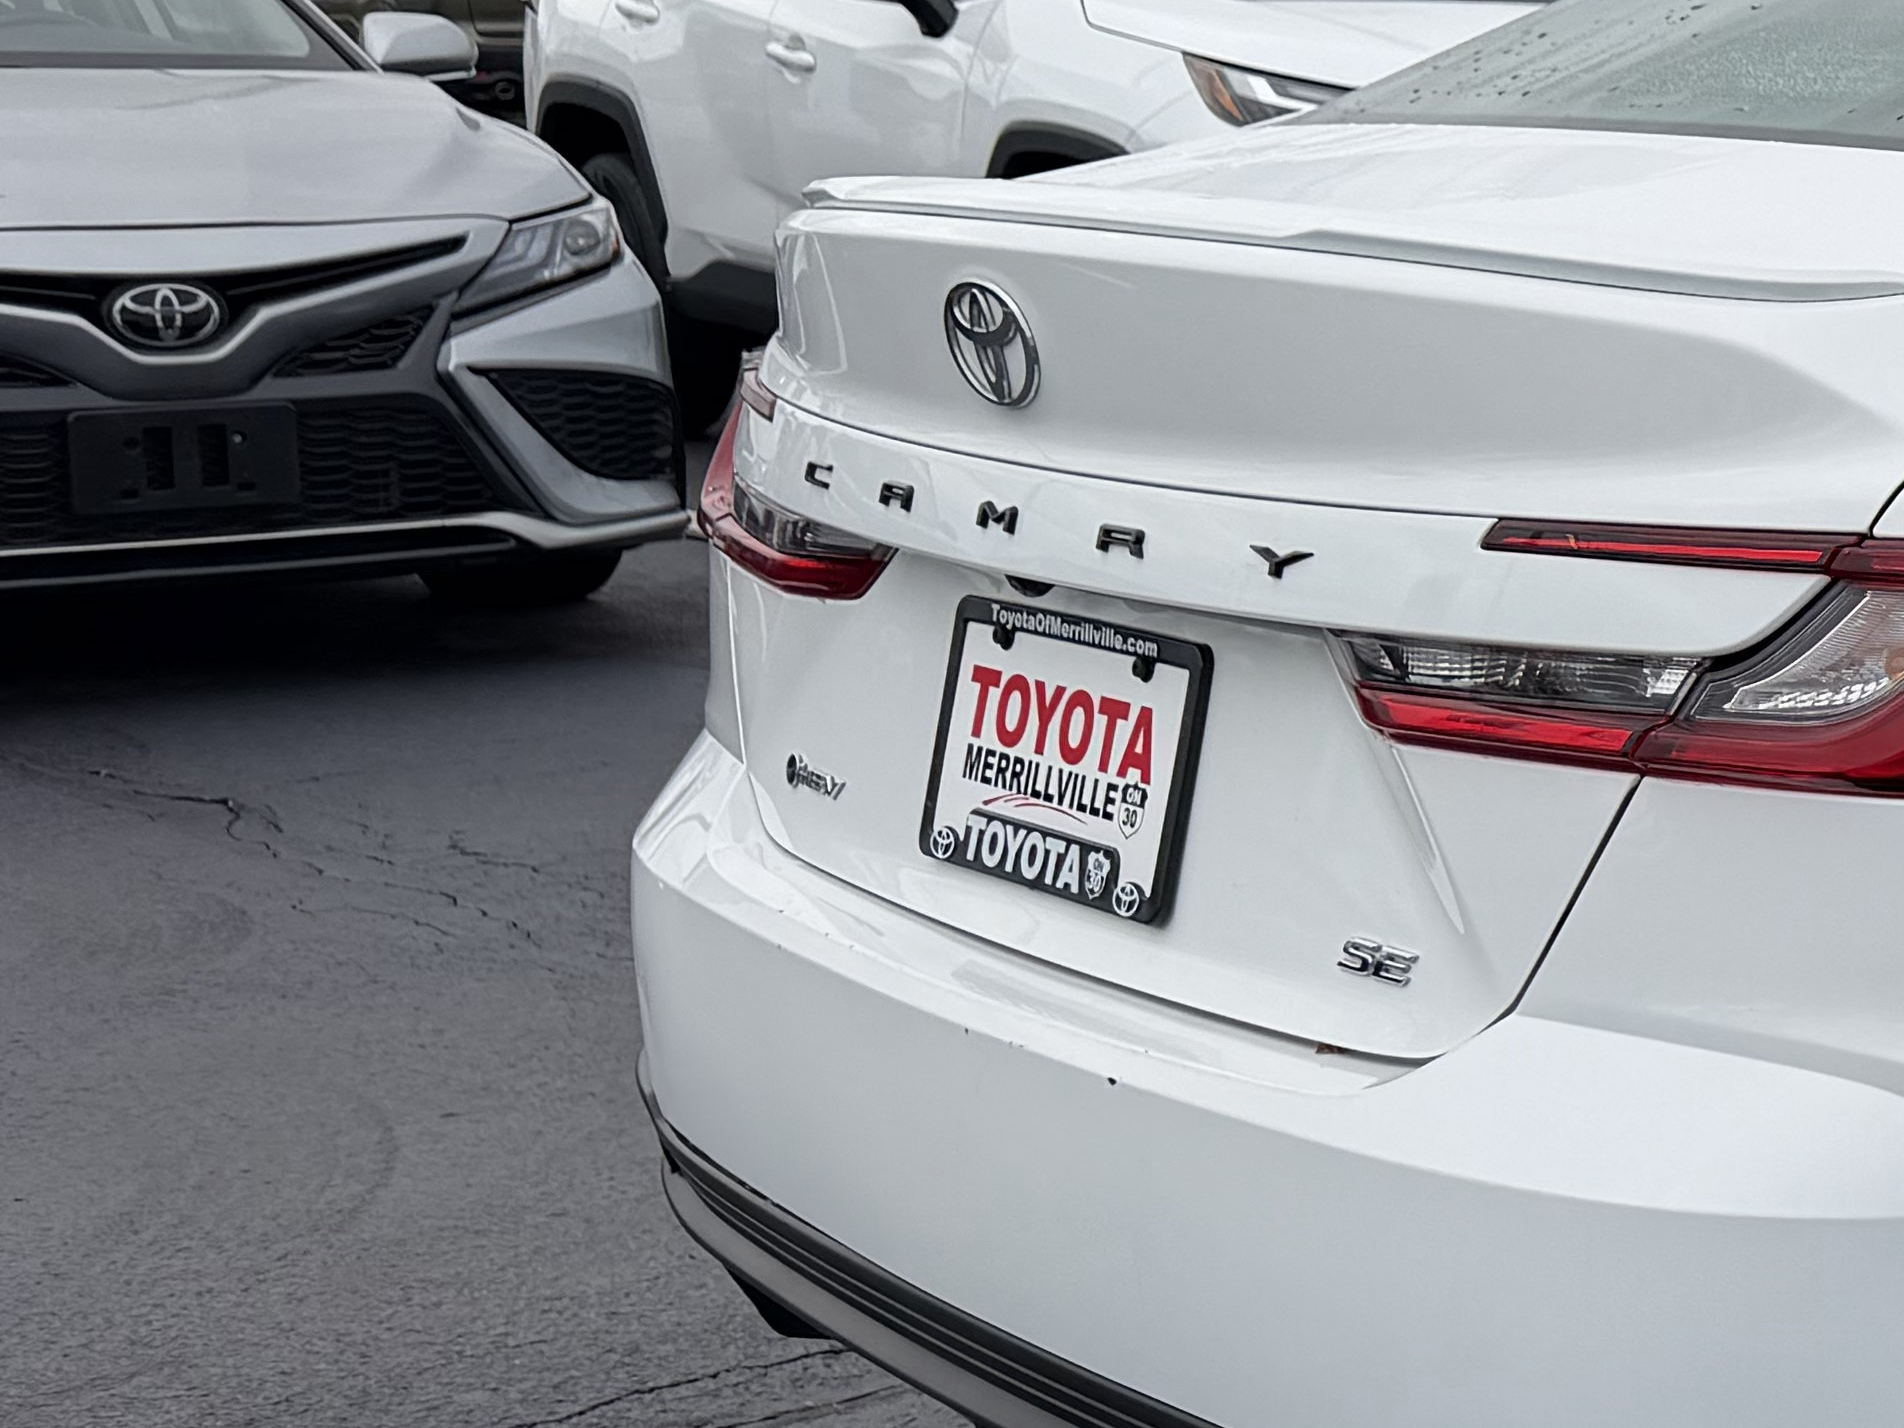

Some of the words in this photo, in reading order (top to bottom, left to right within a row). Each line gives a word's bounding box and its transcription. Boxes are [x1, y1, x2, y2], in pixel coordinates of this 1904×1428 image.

[804, 459, 1314, 579] CAMRY
[990, 603, 1158, 658] ToyotaOfMerrillville.com
[971, 664, 1153, 785] TOYOTA
[962, 743, 1119, 822] MERRILLVILLE
[1126, 787, 1142, 805] ON
[1121, 807, 1138, 829] 30
[966, 814, 1081, 894] TOYOTA
[1086, 869, 1101, 892] 30
[1336, 936, 1420, 988] SE
